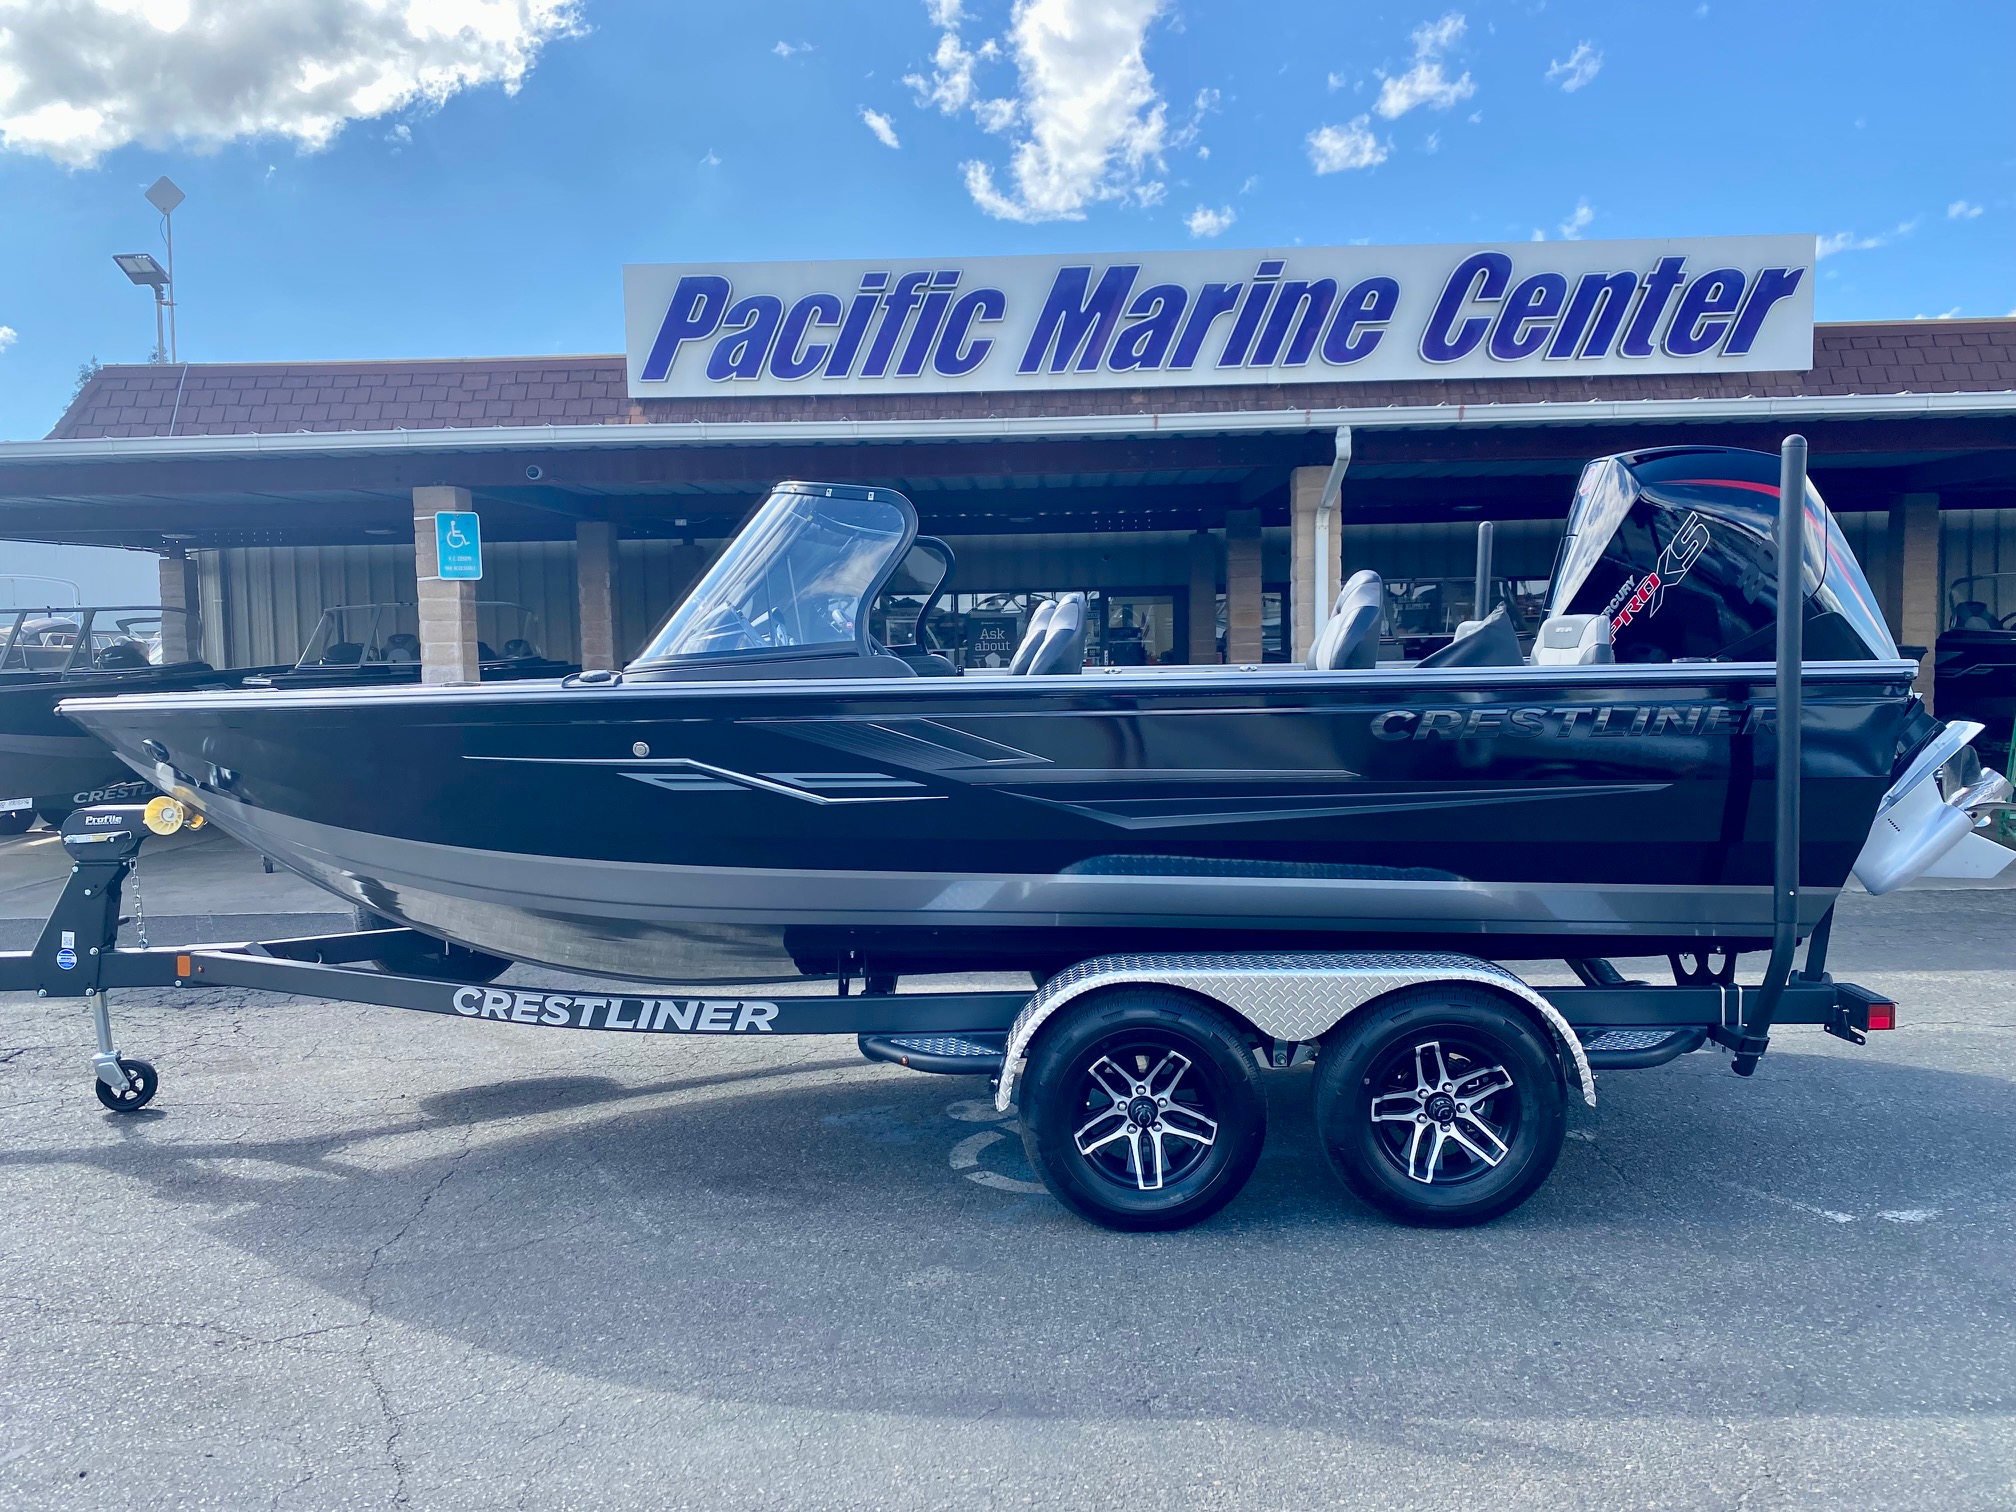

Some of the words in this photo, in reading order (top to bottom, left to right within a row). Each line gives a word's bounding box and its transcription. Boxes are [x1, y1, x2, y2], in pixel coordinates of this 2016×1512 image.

[637, 269, 1007, 383] Pacific
[1014, 258, 1401, 376] Marine
[1418, 250, 1809, 364] Center
[1601, 574, 1635, 616] RCURY
[1610, 572, 1661, 645] PRO
[974, 641, 1011, 651] about
[980, 628, 1005, 640] Ask
[73, 784, 161, 804] CRESTLI
[85, 815, 122, 824] Profile
[452, 986, 780, 1031] CRESTLINER
